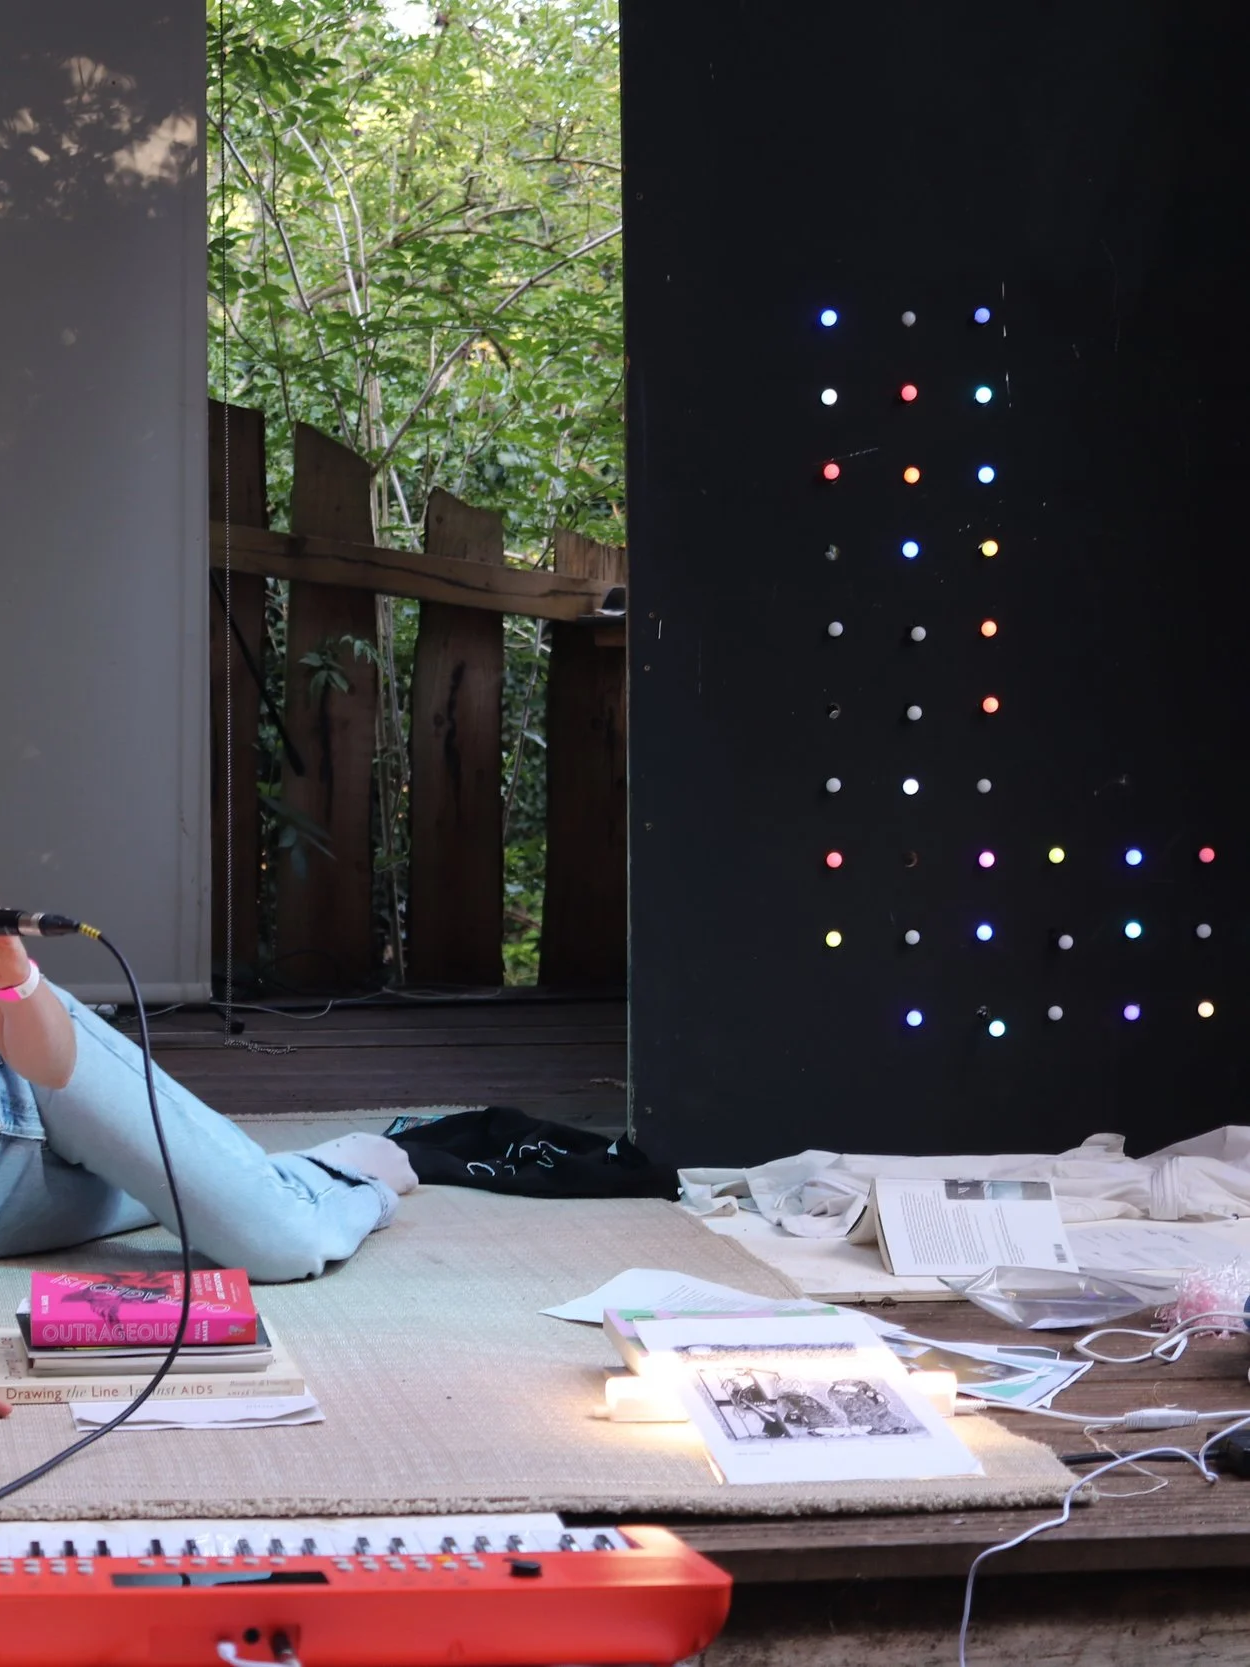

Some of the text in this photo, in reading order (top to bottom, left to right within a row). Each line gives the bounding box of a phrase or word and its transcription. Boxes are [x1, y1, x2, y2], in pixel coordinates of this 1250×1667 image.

[42, 1322, 178, 1342] OUTRAGEOUS
[6, 1388, 62, 1403] Drawing
[66, 1385, 87, 1399] the
[91, 1386, 119, 1398] Line
[123, 1384, 176, 1400] Aginst
[181, 1385, 214, 1396] AIDS
